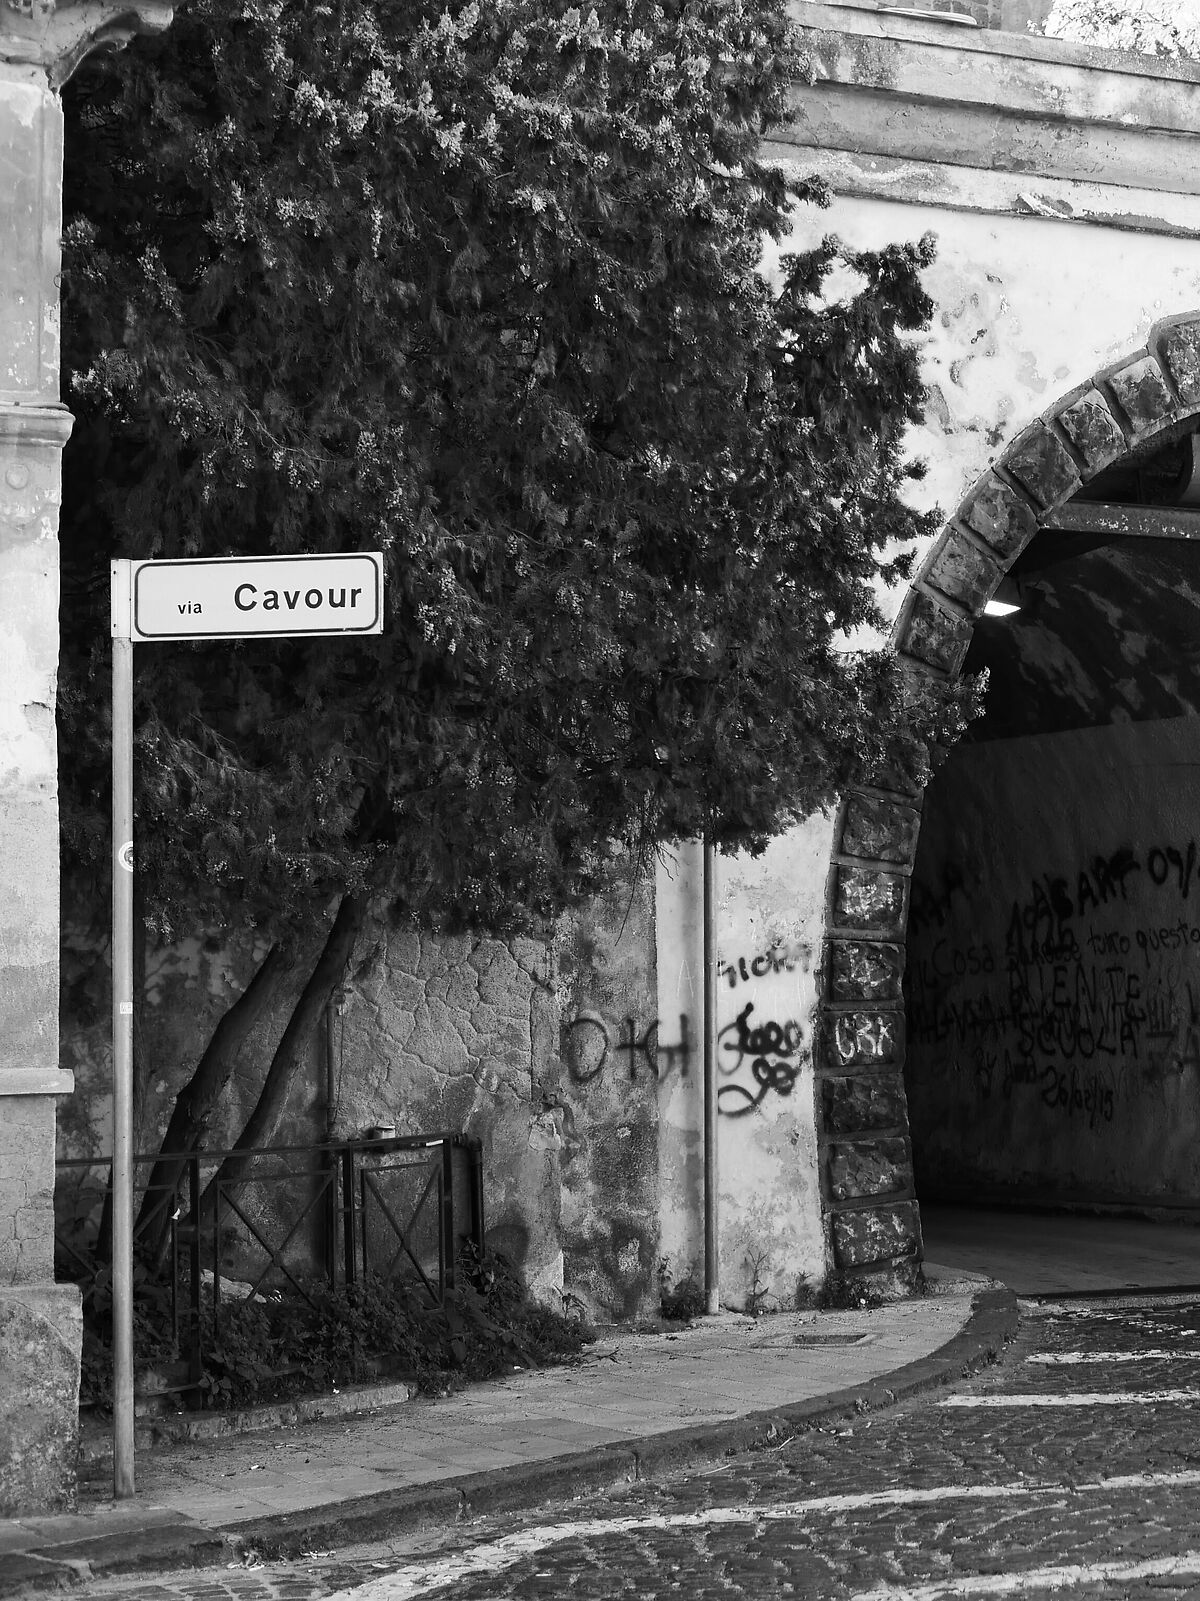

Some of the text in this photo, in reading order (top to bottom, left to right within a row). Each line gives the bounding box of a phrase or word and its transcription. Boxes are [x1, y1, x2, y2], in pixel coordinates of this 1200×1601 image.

[177, 583, 362, 615] via Cavour
[931, 938, 995, 978] Cosa
[1136, 918, 1200, 968] questo
